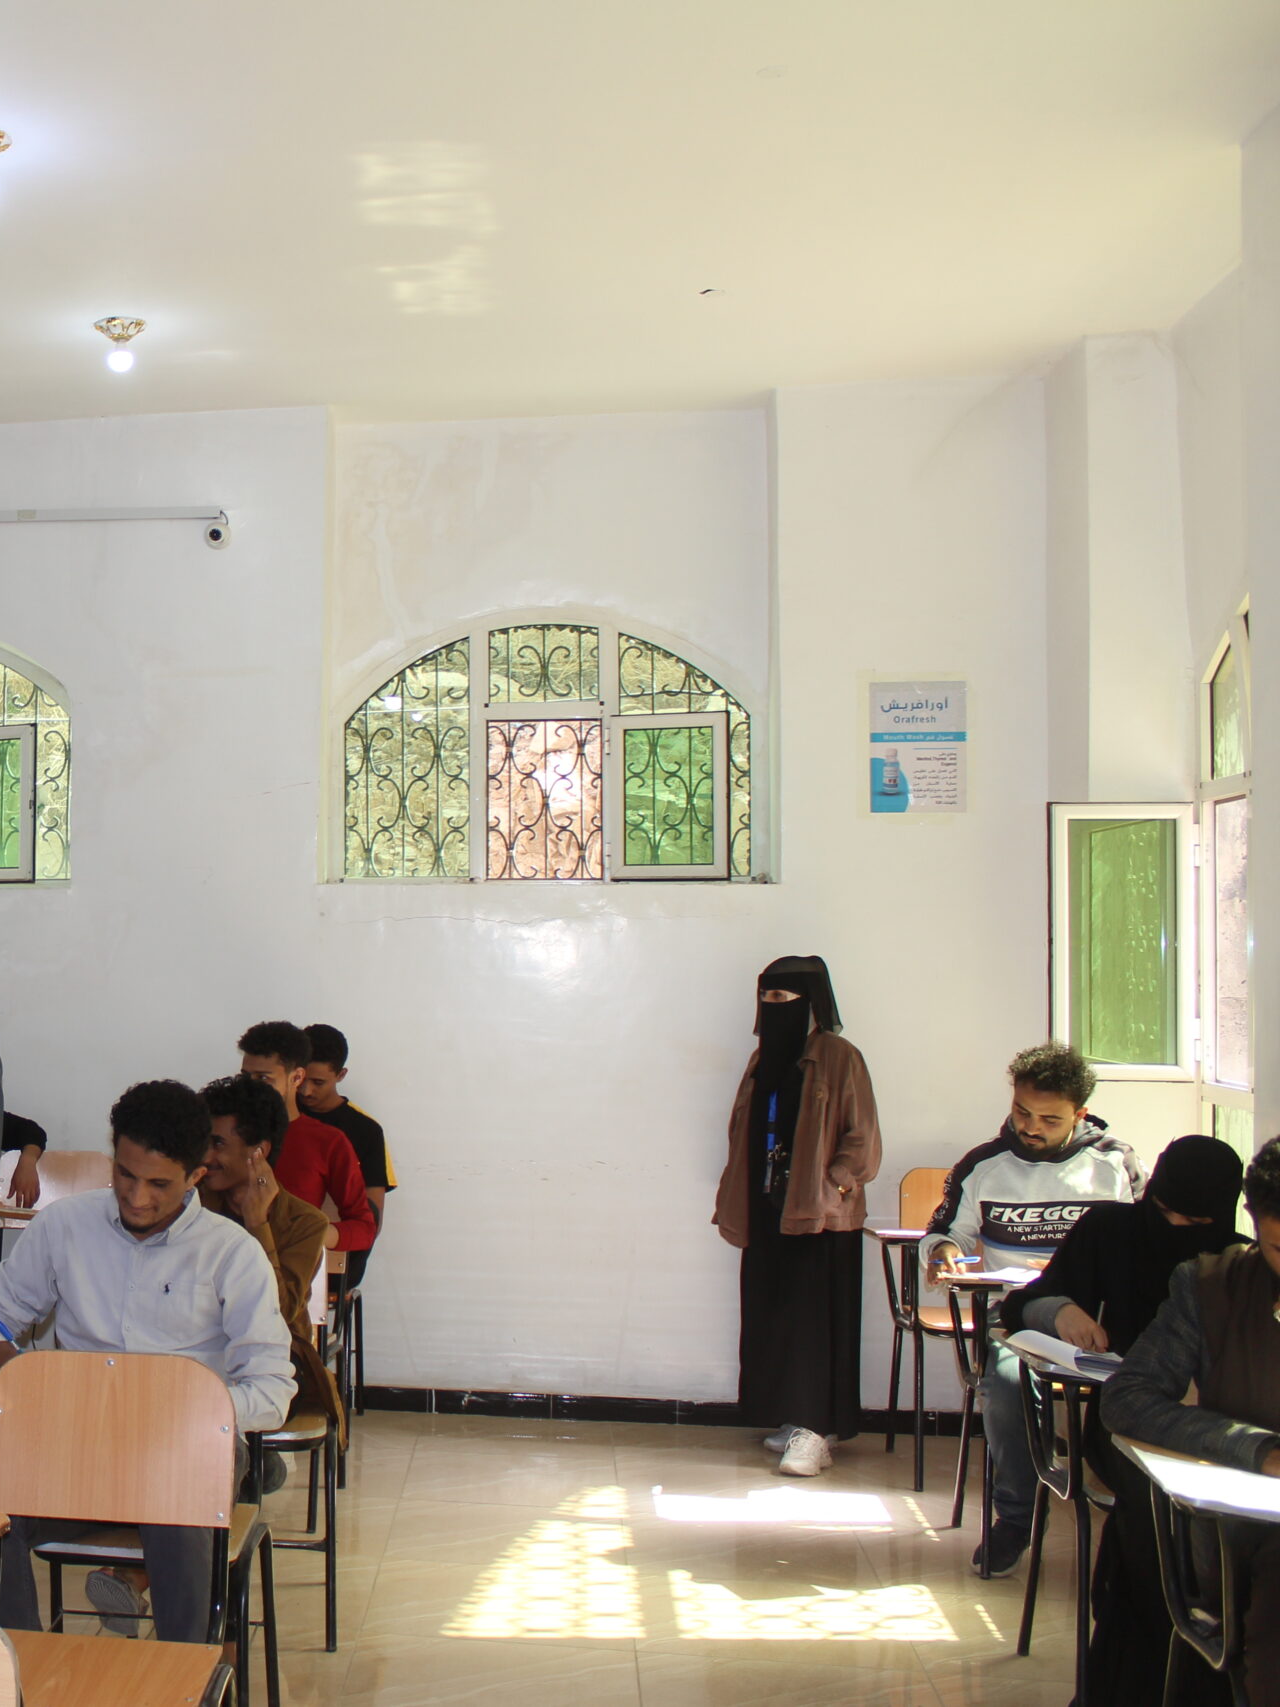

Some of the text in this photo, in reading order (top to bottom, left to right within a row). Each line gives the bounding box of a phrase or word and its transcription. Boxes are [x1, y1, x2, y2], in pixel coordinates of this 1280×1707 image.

[880, 697, 948, 713] أورافريش
[893, 715, 936, 724] Orafresh
[989, 1205, 1091, 1223] FKEGG
[1033, 1223, 1074, 1232] STARTING
[1020, 1234, 1026, 1242] A
[1028, 1233, 1046, 1241] NEW
